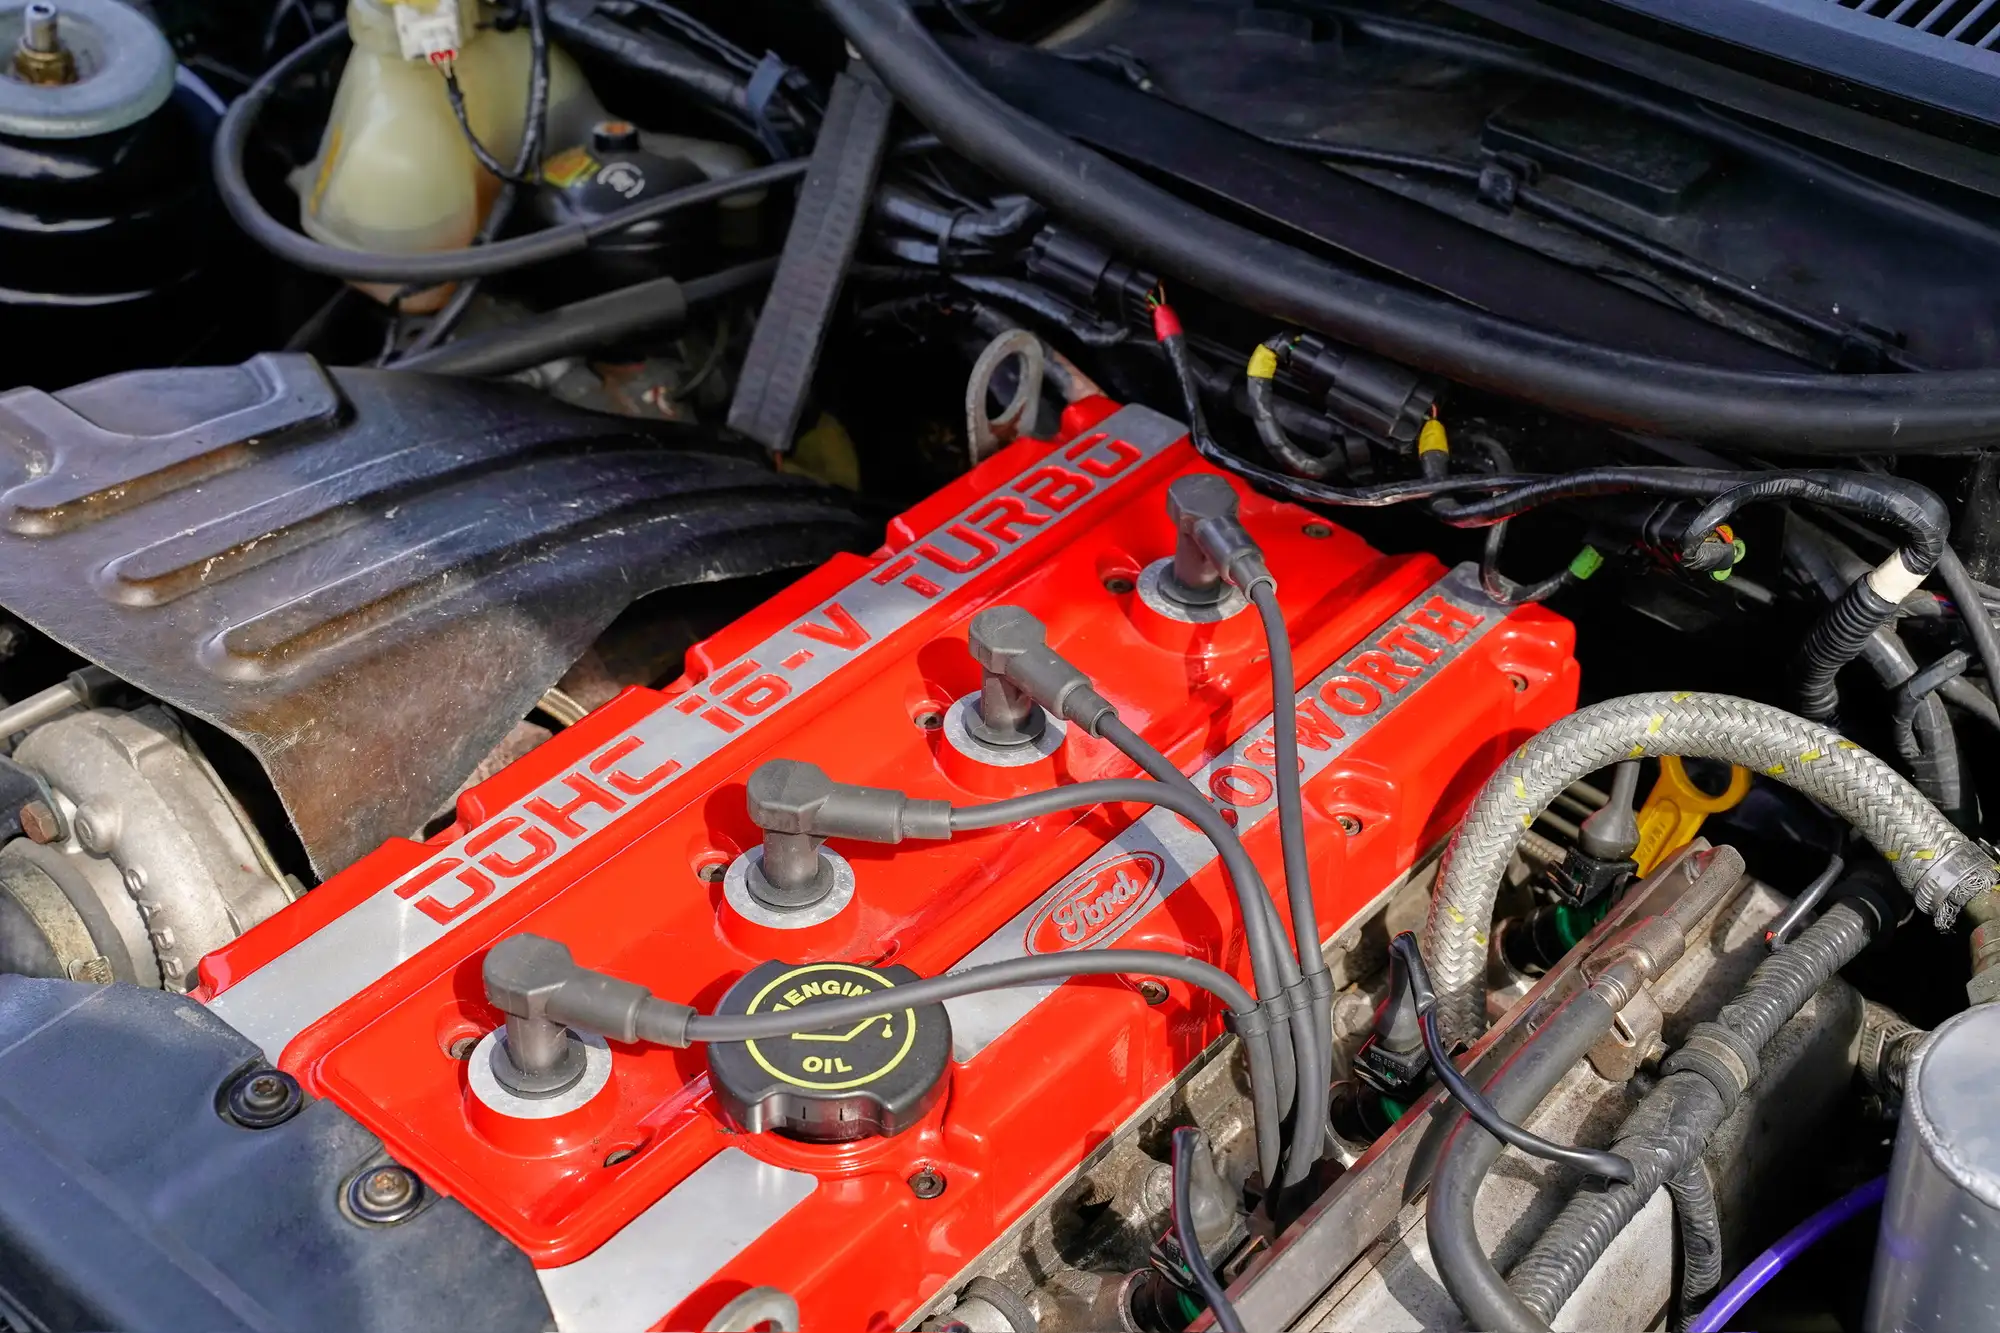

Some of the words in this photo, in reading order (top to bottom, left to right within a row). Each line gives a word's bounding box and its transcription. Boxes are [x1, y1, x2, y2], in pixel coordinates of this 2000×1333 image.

[393, 735, 683, 926] DOHC
[673, 601, 873, 734] 16-V
[870, 432, 1143, 599] TURBO
[1173, 595, 1486, 835] OSWORTH
[1051, 869, 1139, 944] Ford
[783, 980, 873, 1006] ENGIN
[802, 1056, 853, 1074] OIL
